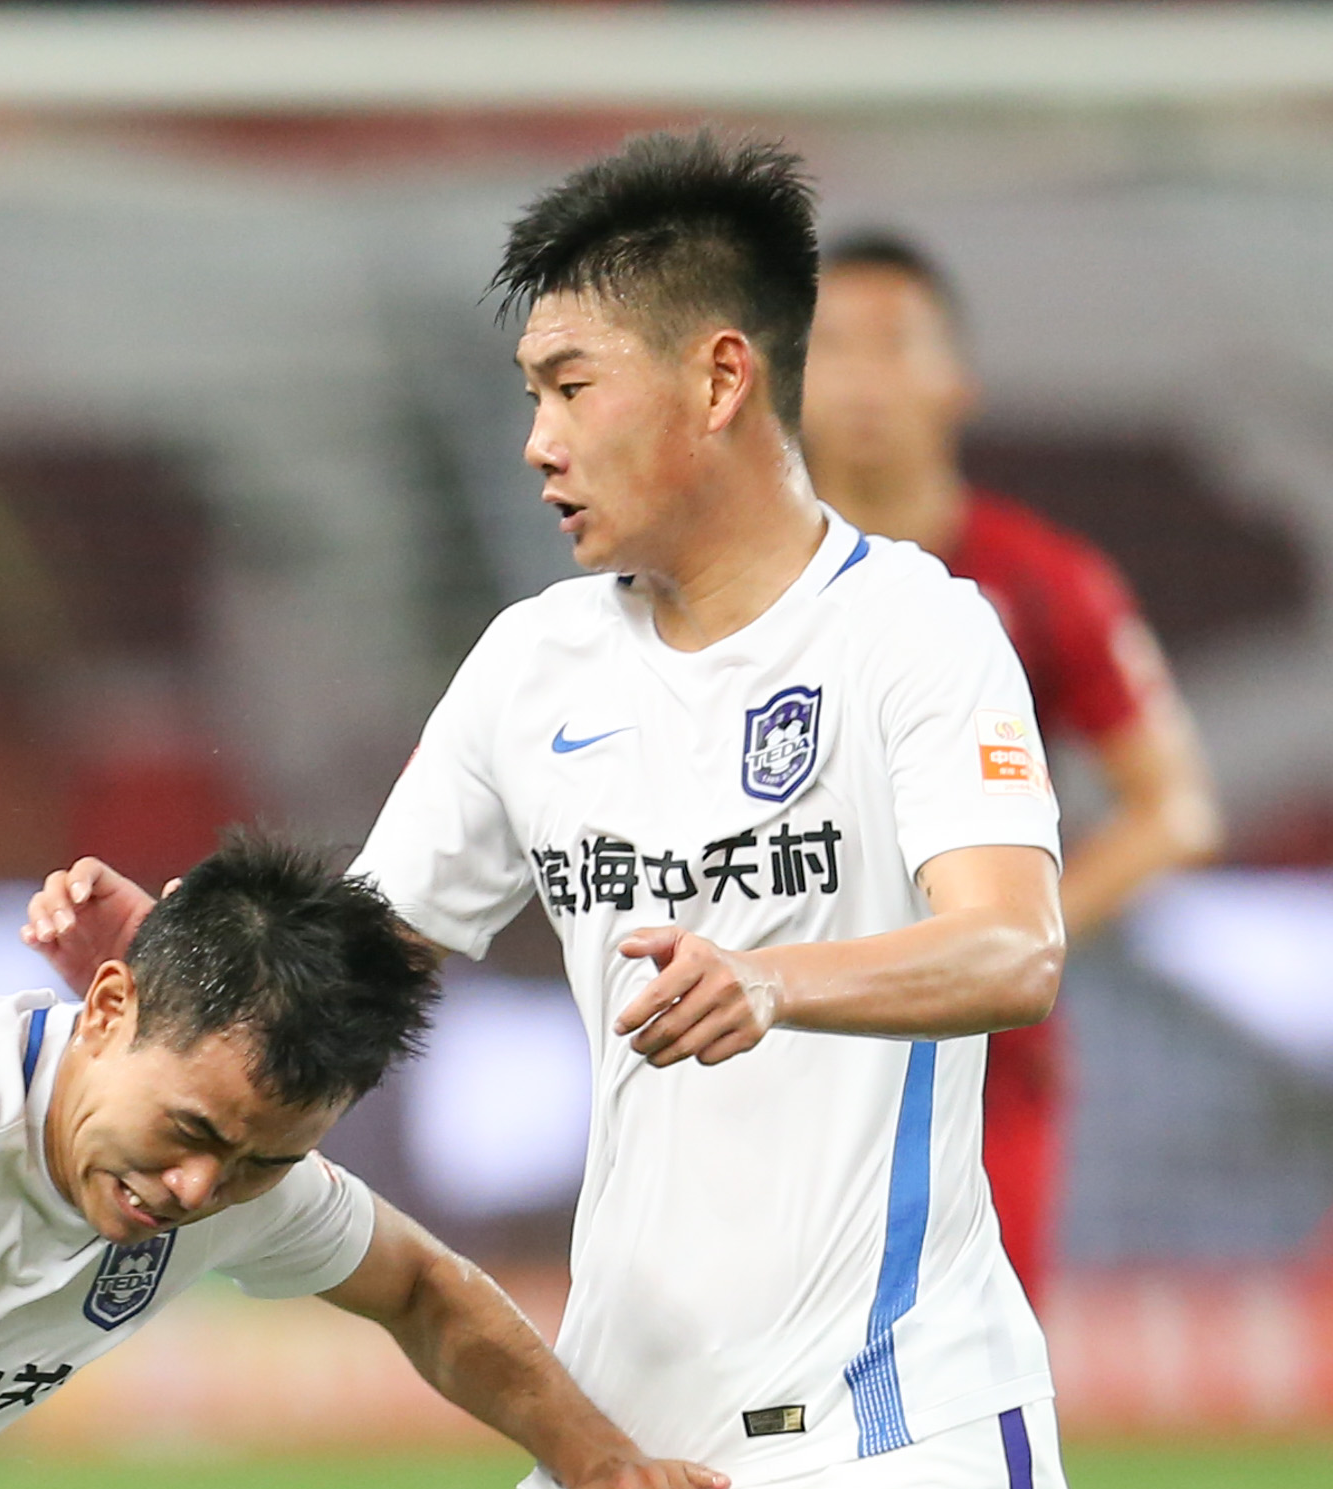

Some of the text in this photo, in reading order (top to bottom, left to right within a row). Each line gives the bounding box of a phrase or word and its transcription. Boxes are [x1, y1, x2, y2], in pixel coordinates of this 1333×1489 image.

[748, 737, 810, 768] TEDA
[531, 821, 842, 920] 滨海中关村
[97, 1272, 153, 1293] TEDA
